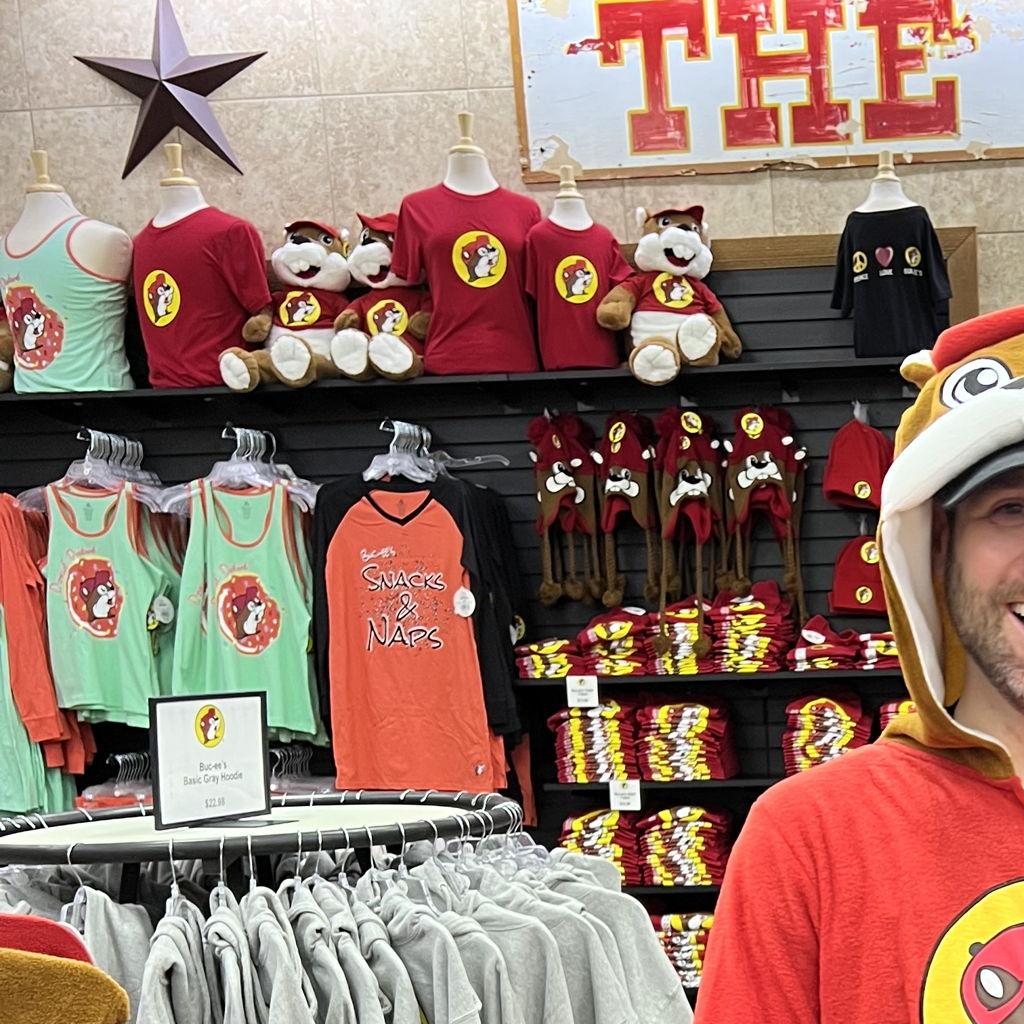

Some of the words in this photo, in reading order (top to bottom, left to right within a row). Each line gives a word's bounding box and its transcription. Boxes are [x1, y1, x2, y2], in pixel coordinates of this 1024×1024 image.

[594, 0, 962, 155] THE
[396, 591, 419, 623] &
[183, 774, 202, 786] Basic
[203, 774, 219, 785] Gray
[220, 771, 243, 781] Hoodie
